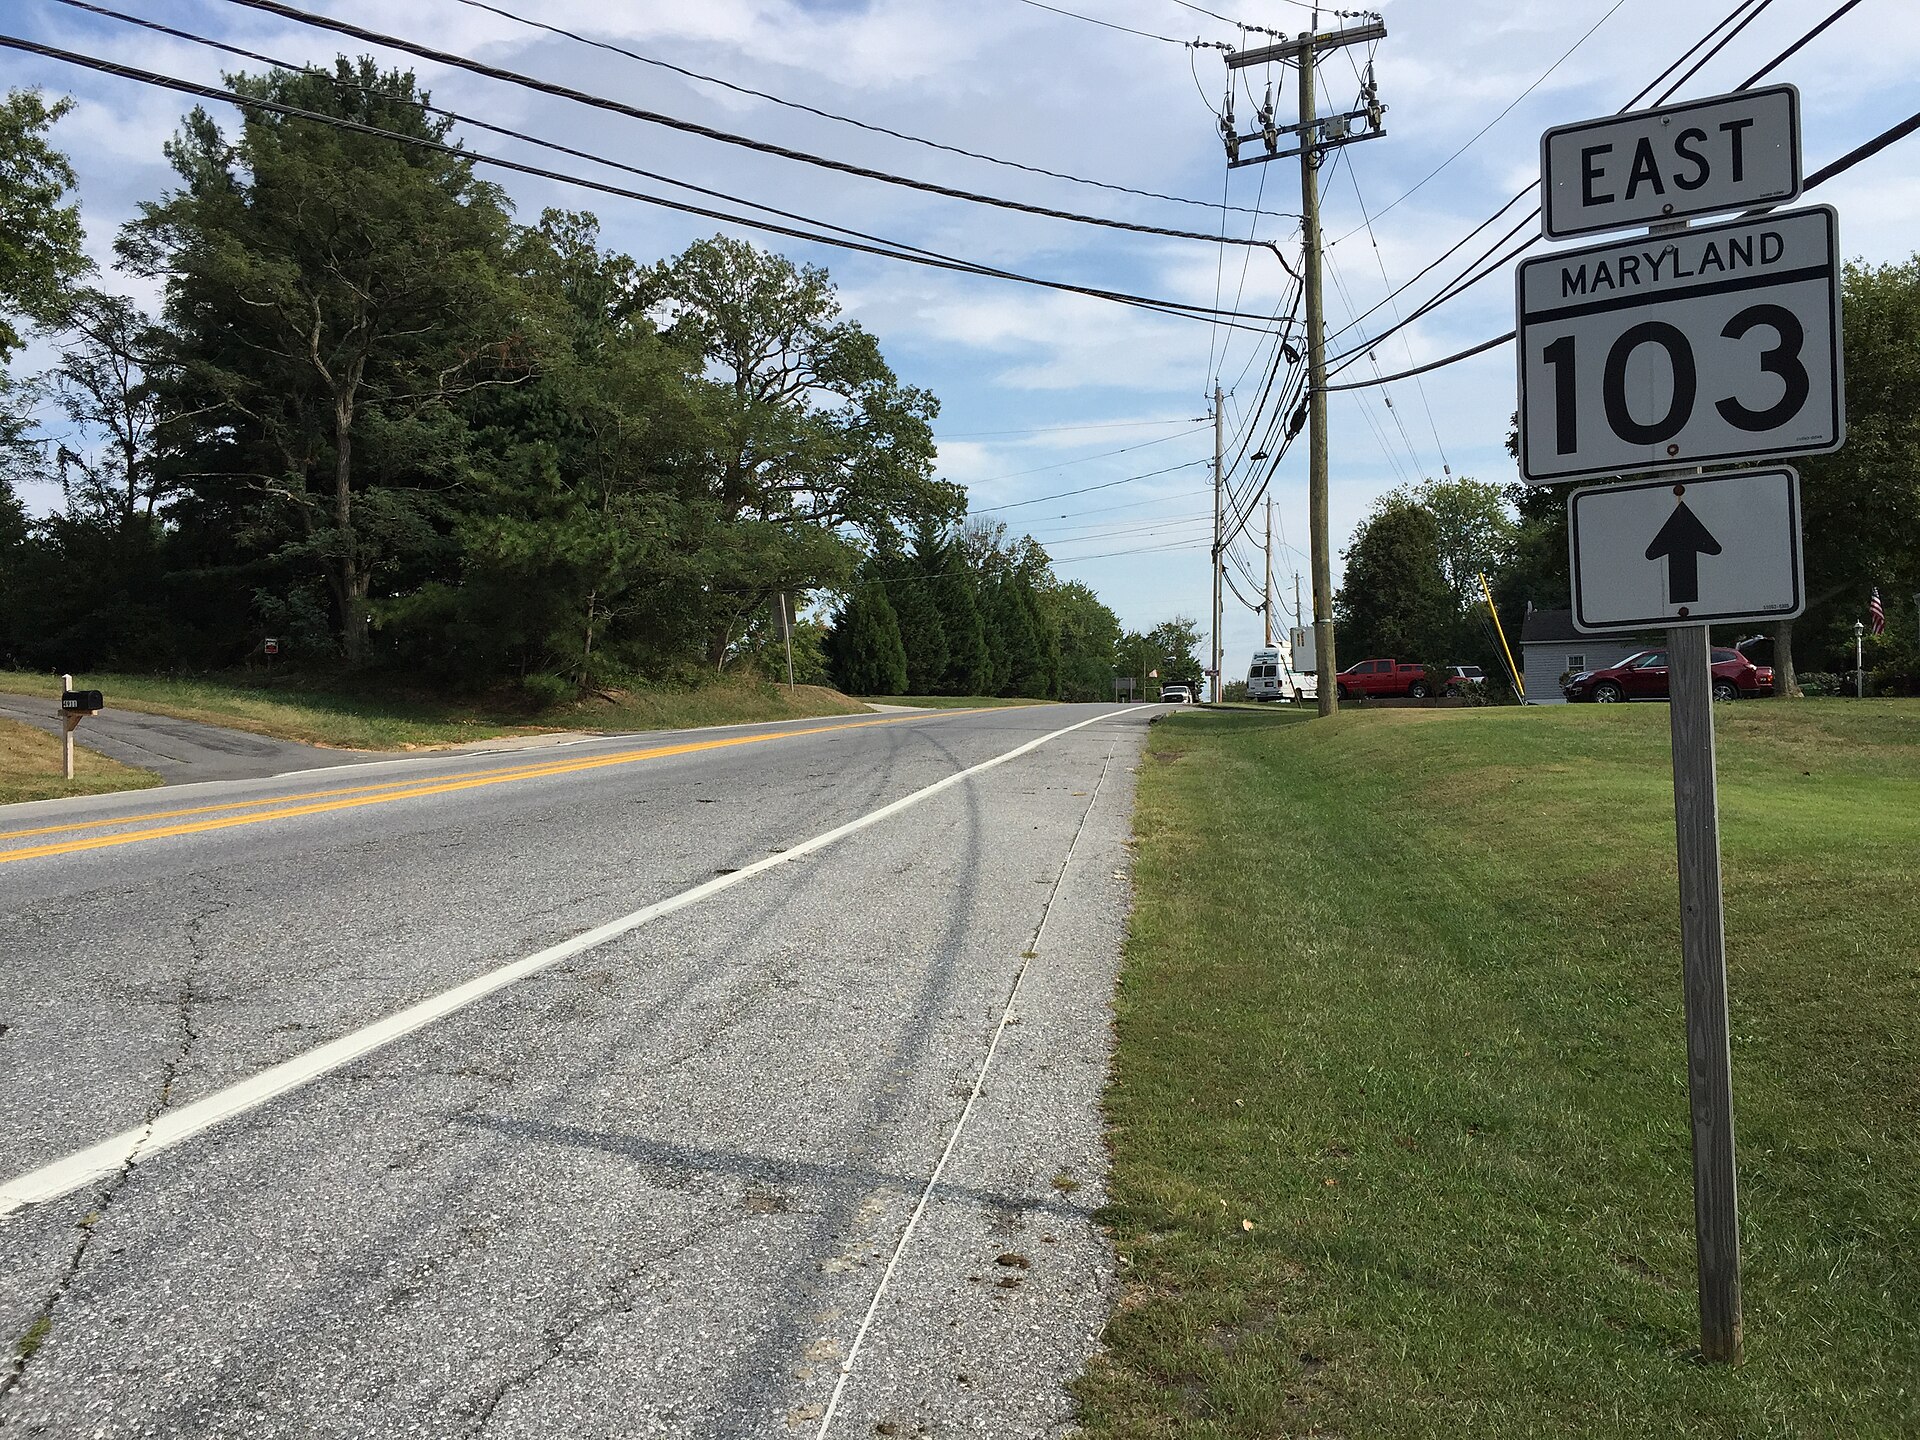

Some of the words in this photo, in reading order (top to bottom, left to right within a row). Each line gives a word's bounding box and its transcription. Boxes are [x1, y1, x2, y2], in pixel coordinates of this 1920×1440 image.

[1581, 118, 1754, 207] EAST
[1561, 231, 1784, 297] MARYLAND
[1543, 304, 1809, 455] 103
